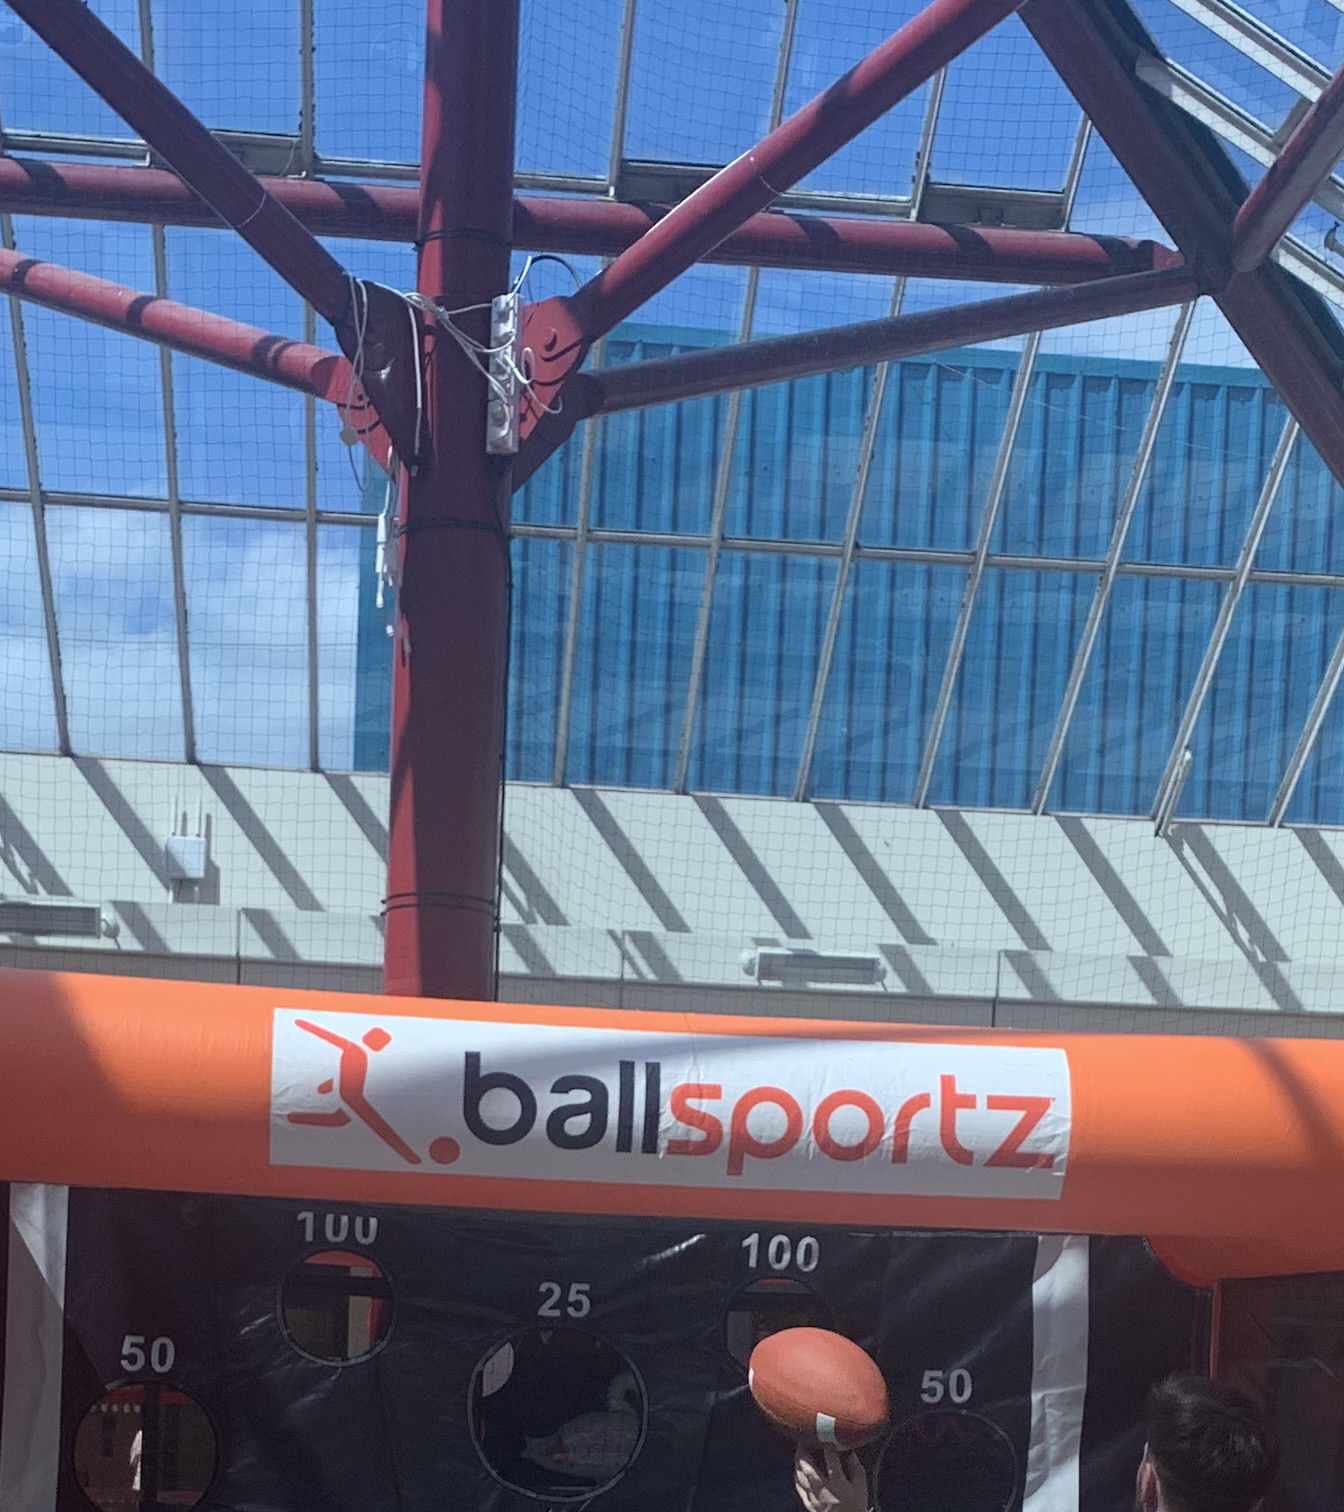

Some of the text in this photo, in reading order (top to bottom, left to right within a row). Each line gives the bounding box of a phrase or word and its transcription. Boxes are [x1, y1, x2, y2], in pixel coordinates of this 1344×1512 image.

[464, 1050, 1056, 1176] ballsportz
[297, 1211, 378, 1245] 100
[741, 1232, 820, 1272] 100
[537, 1283, 592, 1319] 25
[120, 1334, 176, 1374] 50
[920, 1368, 973, 1404] 50
